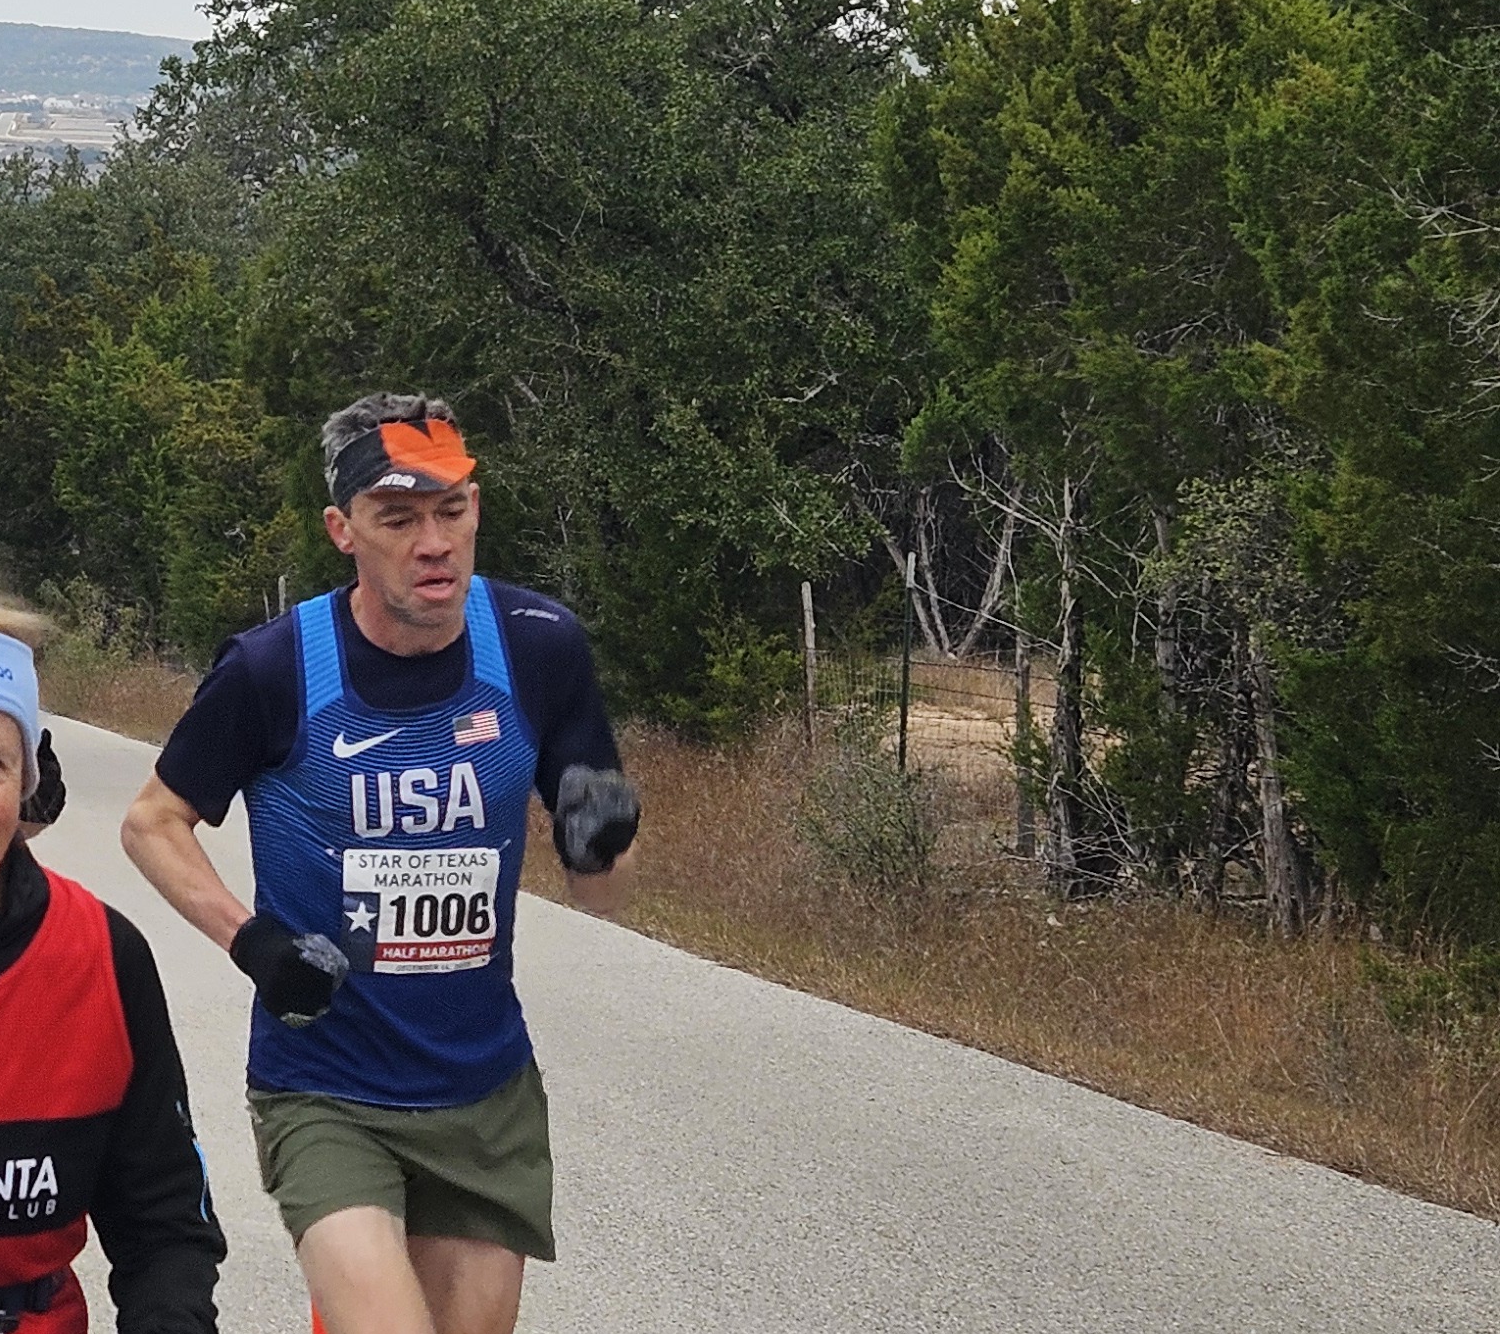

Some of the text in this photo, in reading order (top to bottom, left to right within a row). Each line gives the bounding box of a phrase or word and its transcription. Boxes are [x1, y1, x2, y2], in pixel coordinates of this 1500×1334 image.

[350, 761, 486, 839] USA
[358, 851, 488, 869] STAR OF TEXAS
[373, 871, 473, 888] MARATHON
[388, 891, 491, 938] 1006
[382, 946, 417, 959] HALF
